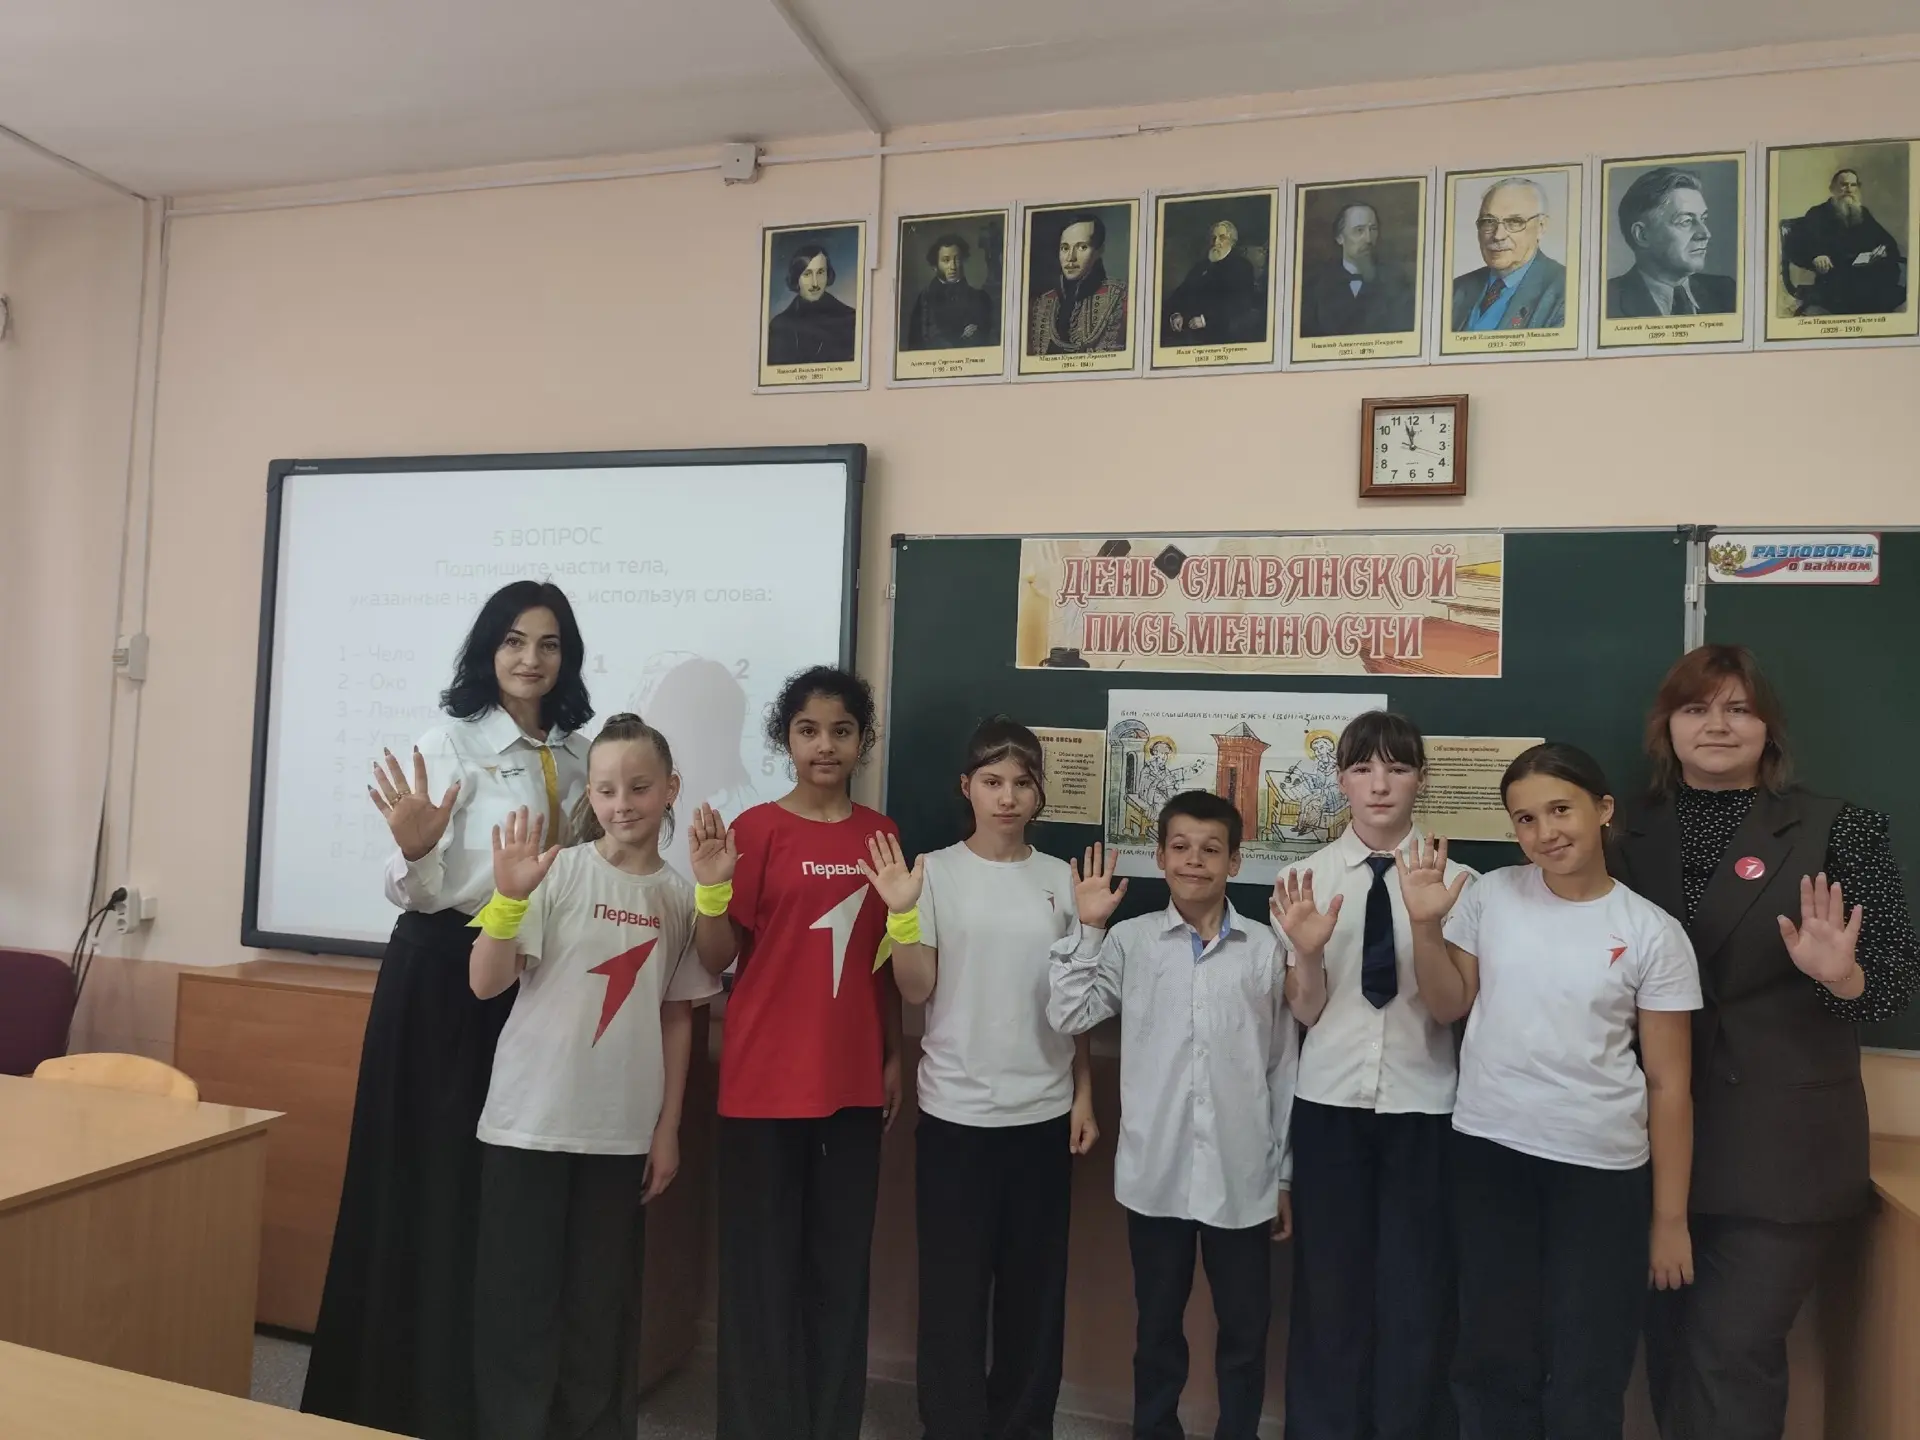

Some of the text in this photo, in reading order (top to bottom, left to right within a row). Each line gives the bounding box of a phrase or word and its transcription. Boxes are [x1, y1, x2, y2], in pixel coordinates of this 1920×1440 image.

[1390, 415, 1401, 427] 11
[1407, 415, 1420, 426] 12
[1429, 414, 1435, 425] 1
[1439, 423, 1447, 434] 2
[1379, 425, 1391, 436] 10
[1381, 443, 1388, 453] 9
[1438, 441, 1446, 451] 3
[1380, 459, 1388, 469] 8
[1438, 457, 1446, 467] 4
[1390, 469, 1399, 480] 7
[1409, 468, 1417, 479] 6
[1427, 468, 1435, 478] 5
[492, 526, 604, 548] 5 ВОПРОС
[1751, 543, 1875, 560] РАЗГОВОРЫ
[435, 556, 670, 583] Подпишите части тела,
[1056, 543, 1459, 608] ДЕНЬ СЛАВЯНСКОЙ
[349, 591, 451, 613] указанные
[456, 591, 479, 607] на
[588, 588, 698, 609] используя
[703, 586, 775, 604] слова:
[1080, 611, 1425, 660] ПИСЬМЕННОСТИ
[338, 646, 347, 662] 1
[367, 644, 416, 663] Чело
[593, 654, 608, 674] 1
[734, 658, 750, 680] 2
[337, 672, 349, 691] 2
[369, 672, 408, 691] Око
[335, 700, 348, 718] 3
[334, 728, 347, 746] 4
[369, 729, 411, 746] Уста
[760, 755, 777, 777] 5
[593, 903, 661, 930] Первые
